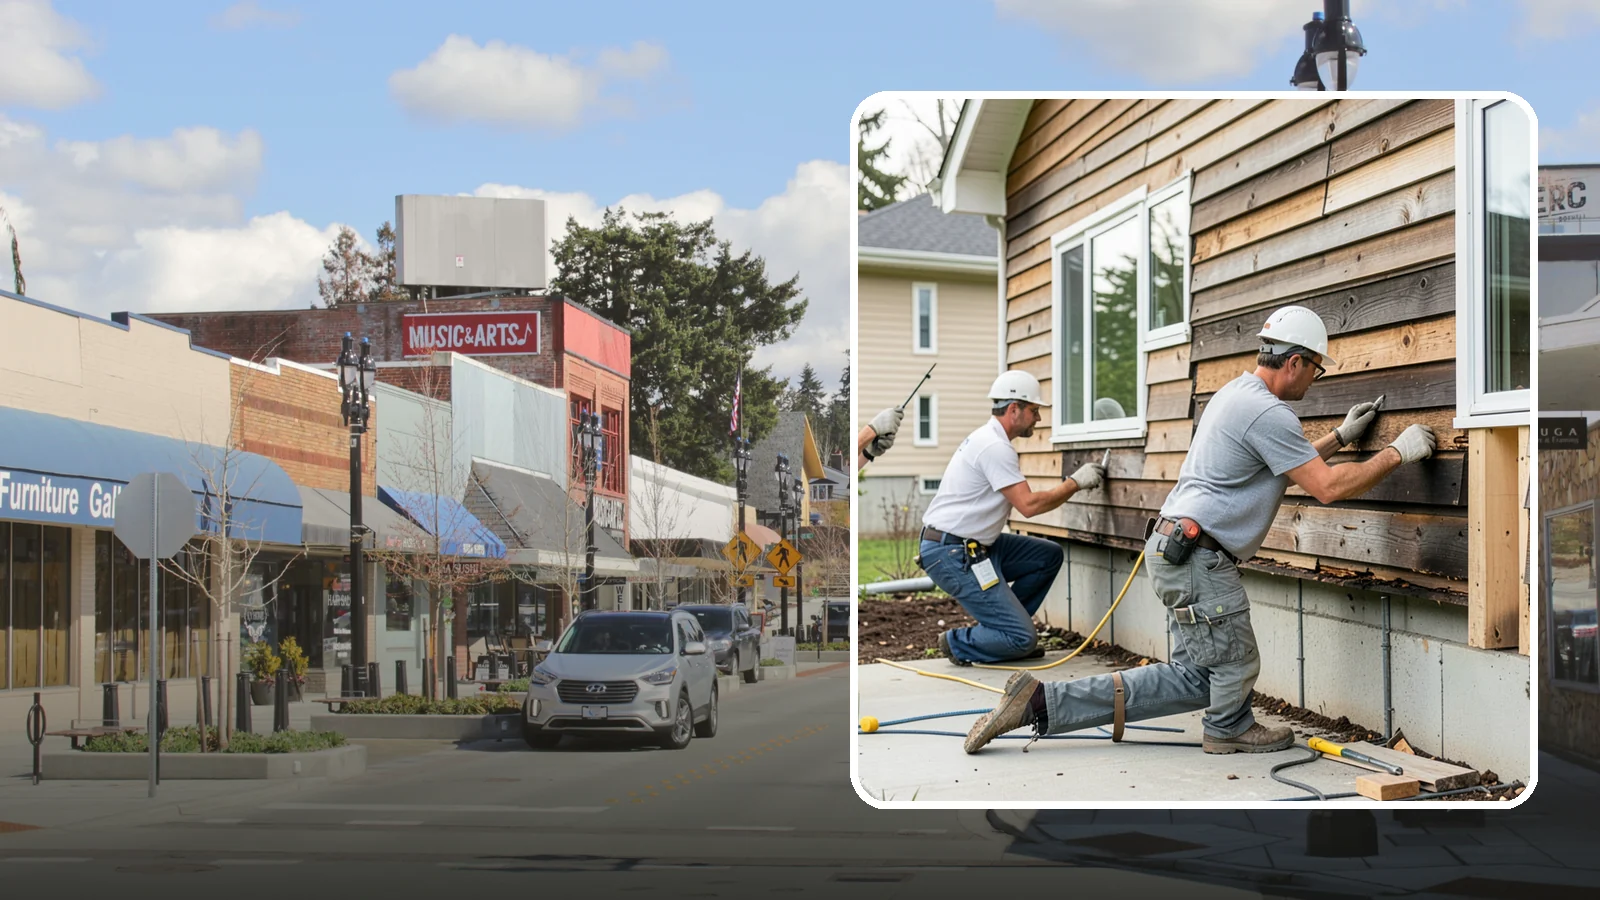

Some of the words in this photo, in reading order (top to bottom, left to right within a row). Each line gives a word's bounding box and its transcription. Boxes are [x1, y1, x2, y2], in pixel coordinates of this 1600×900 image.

[1538, 181, 1586, 212] ERC
[1540, 428, 1577, 436] UGA
[0, 471, 79, 515] Furniture
[89, 482, 121, 519] Gal
[453, 563, 479, 574] SUSHI
